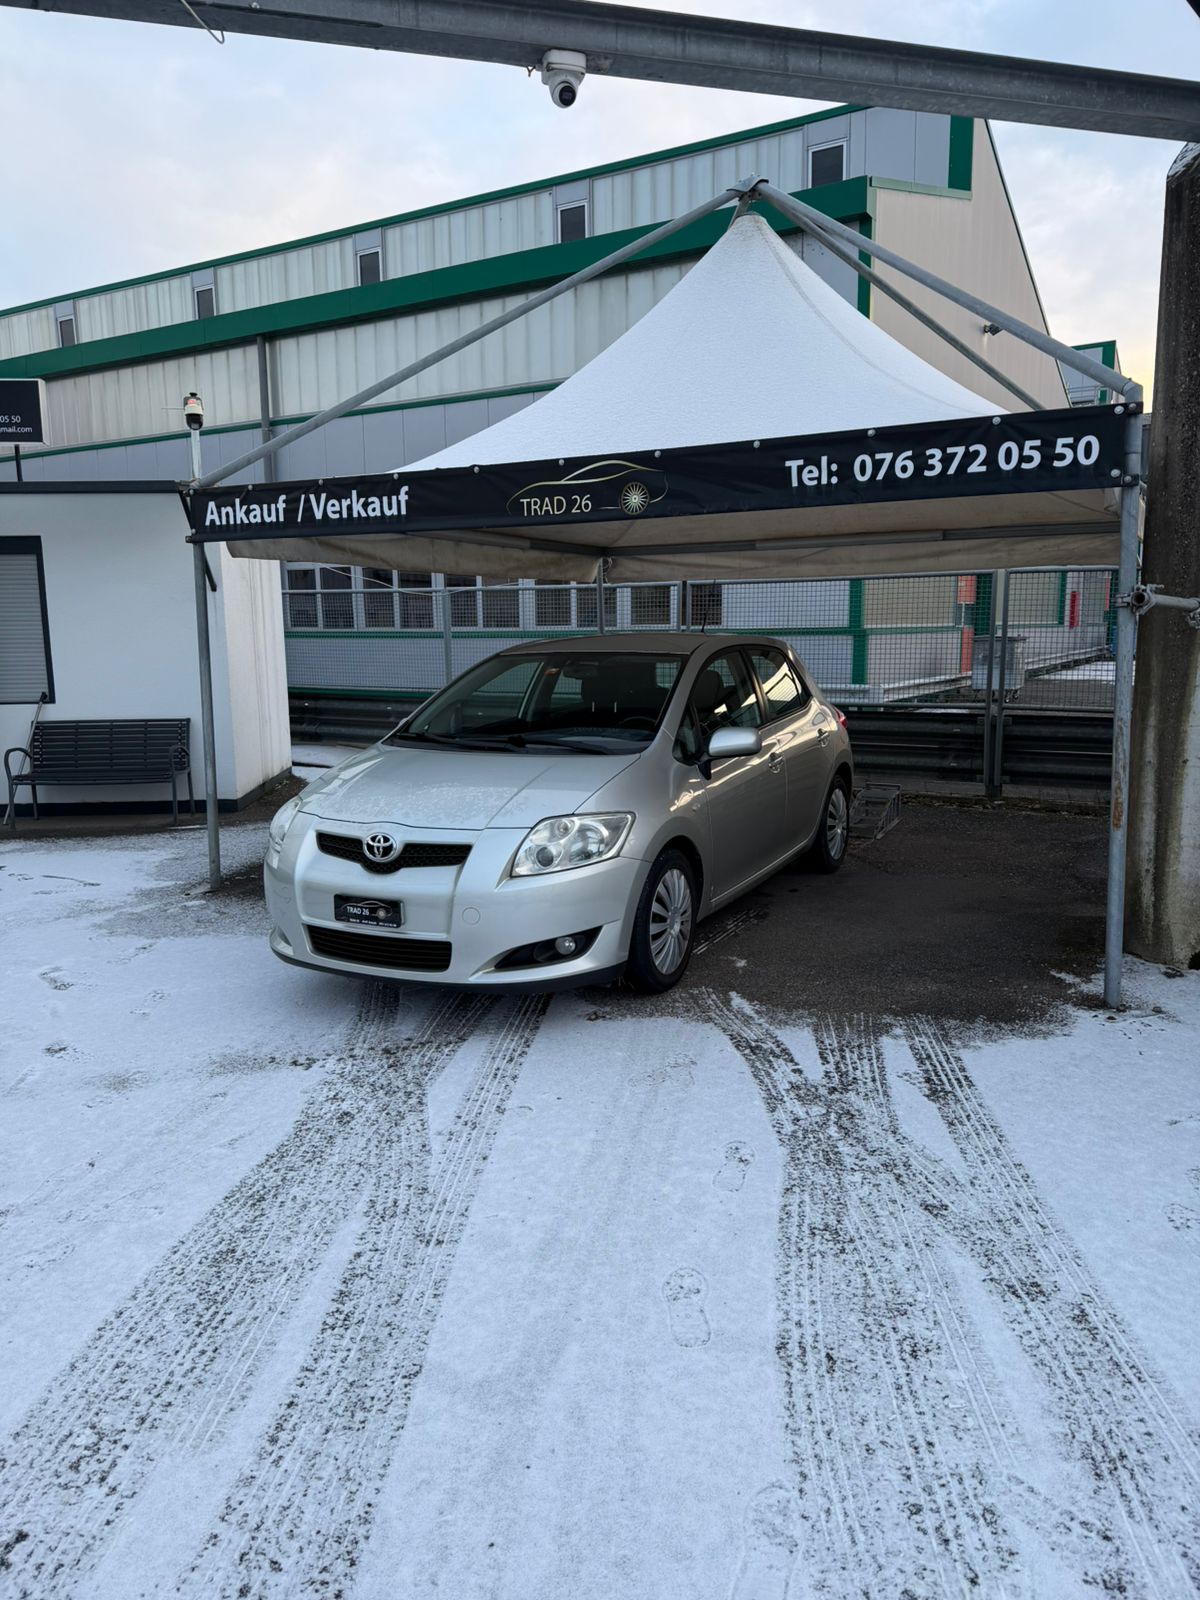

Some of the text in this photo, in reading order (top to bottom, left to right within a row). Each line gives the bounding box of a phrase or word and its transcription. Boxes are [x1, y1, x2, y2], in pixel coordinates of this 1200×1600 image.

[11, 415, 21, 423] 50
[0, 425, 33, 433] mail.com
[785, 435, 1100, 487] Tel: 076 372 05 50
[204, 495, 287, 526] Ankauf
[520, 494, 593, 517] TRAD 26
[346, 905, 362, 915] TRAD
